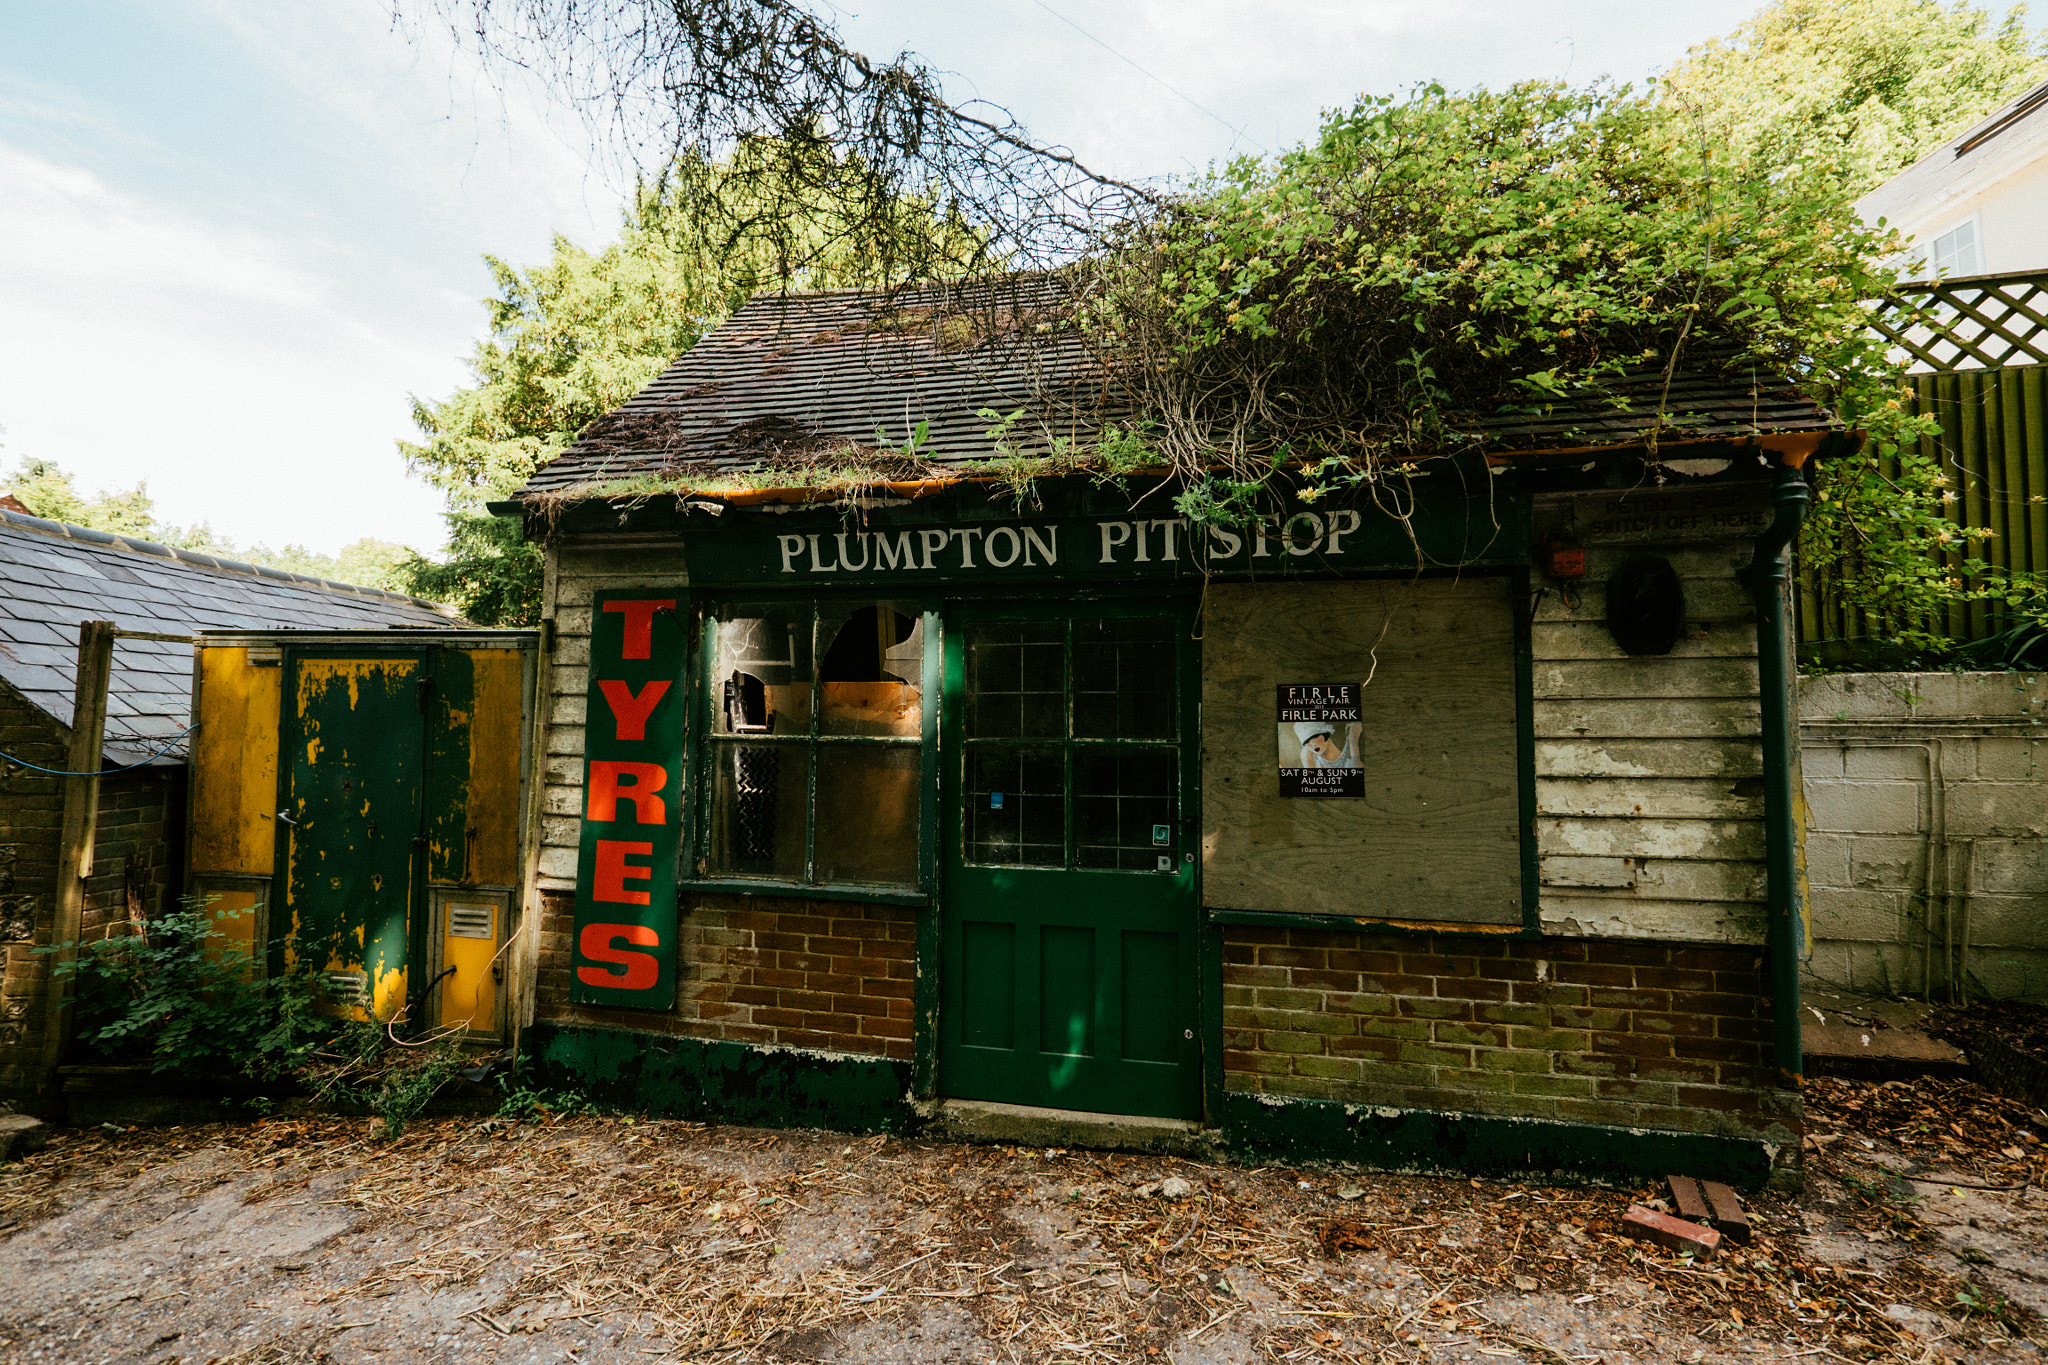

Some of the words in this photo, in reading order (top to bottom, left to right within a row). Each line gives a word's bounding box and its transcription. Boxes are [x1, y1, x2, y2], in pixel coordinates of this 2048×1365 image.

[1591, 516, 1658, 534] SWITCH
[1666, 514, 1703, 530] OFF
[1711, 510, 1766, 528] HERE
[778, 524, 1059, 574] PLUMPTON
[1097, 517, 1187, 564] PIT
[1209, 510, 1362, 560] STOP
[1289, 687, 1349, 698] FIRLE
[1282, 710, 1317, 720] FIRLE
[1322, 709, 1357, 720] PARK
[1281, 769, 1299, 777] SAT
[1317, 769, 1324, 777] &
[1326, 769, 1348, 777] SUN
[1301, 777, 1342, 785] AUGUST
[577, 598, 677, 991] TYRES
